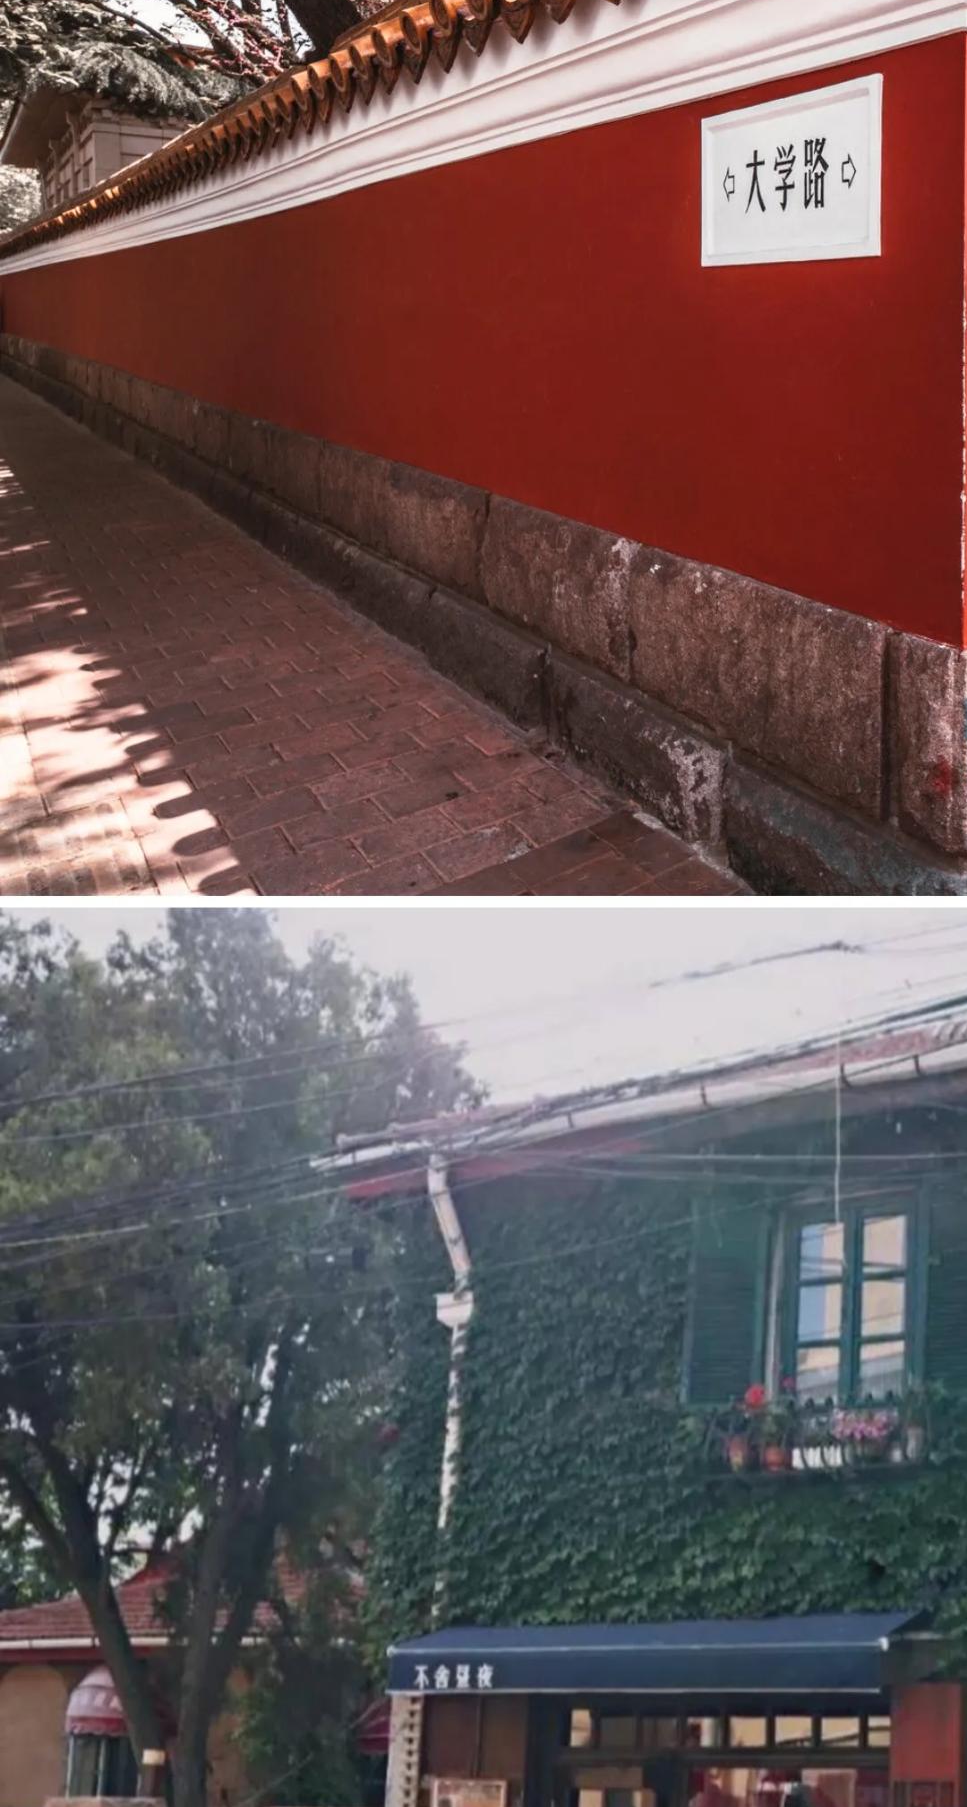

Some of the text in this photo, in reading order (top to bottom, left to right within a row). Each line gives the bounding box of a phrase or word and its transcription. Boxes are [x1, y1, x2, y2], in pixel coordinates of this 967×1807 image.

[744, 137, 830, 214] 大学路
[413, 1663, 495, 1691] 不舍昼夜
